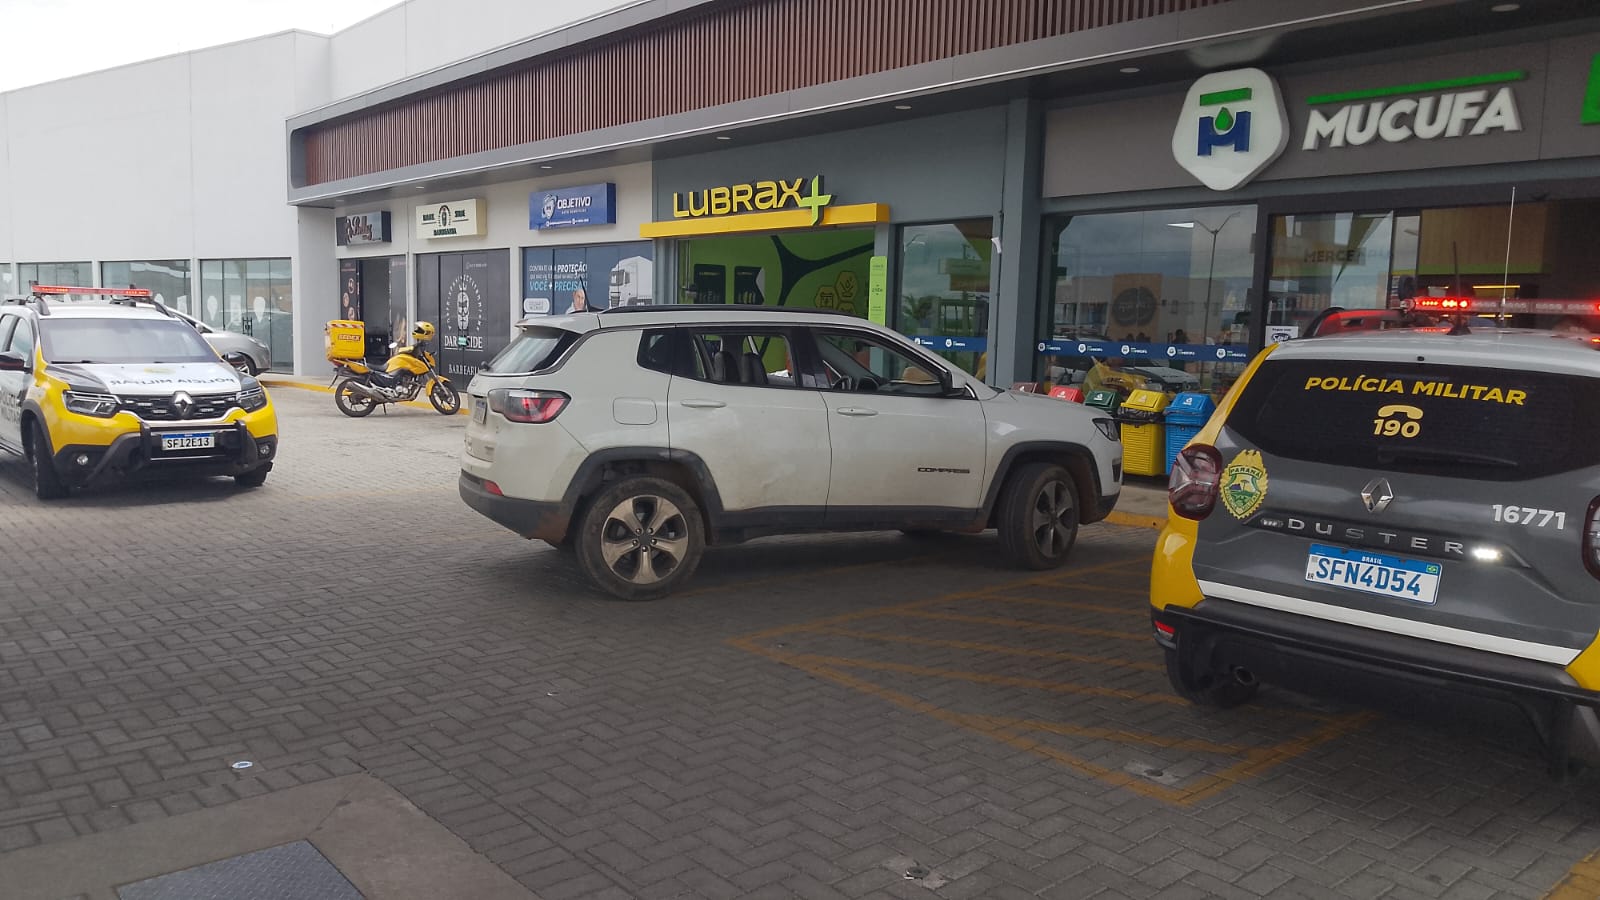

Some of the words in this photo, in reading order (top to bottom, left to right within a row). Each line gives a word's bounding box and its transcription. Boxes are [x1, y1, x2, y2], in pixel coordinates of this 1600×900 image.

[1301, 87, 1522, 151] MUCUFA
[557, 196, 591, 209] OBJETIVO
[444, 335, 461, 347] DAR
[467, 335, 483, 349] SIDE
[1304, 374, 1404, 394] POLÍCIA
[1412, 381, 1527, 406] MILITAR
[1374, 418, 1421, 438] 190
[167, 437, 210, 449] SFI2E13
[1492, 504, 1567, 530] 16771
[1287, 518, 1465, 555] DUSTER
[1361, 556, 1383, 565] BRASIL
[1316, 557, 1421, 596] SFN4D54
